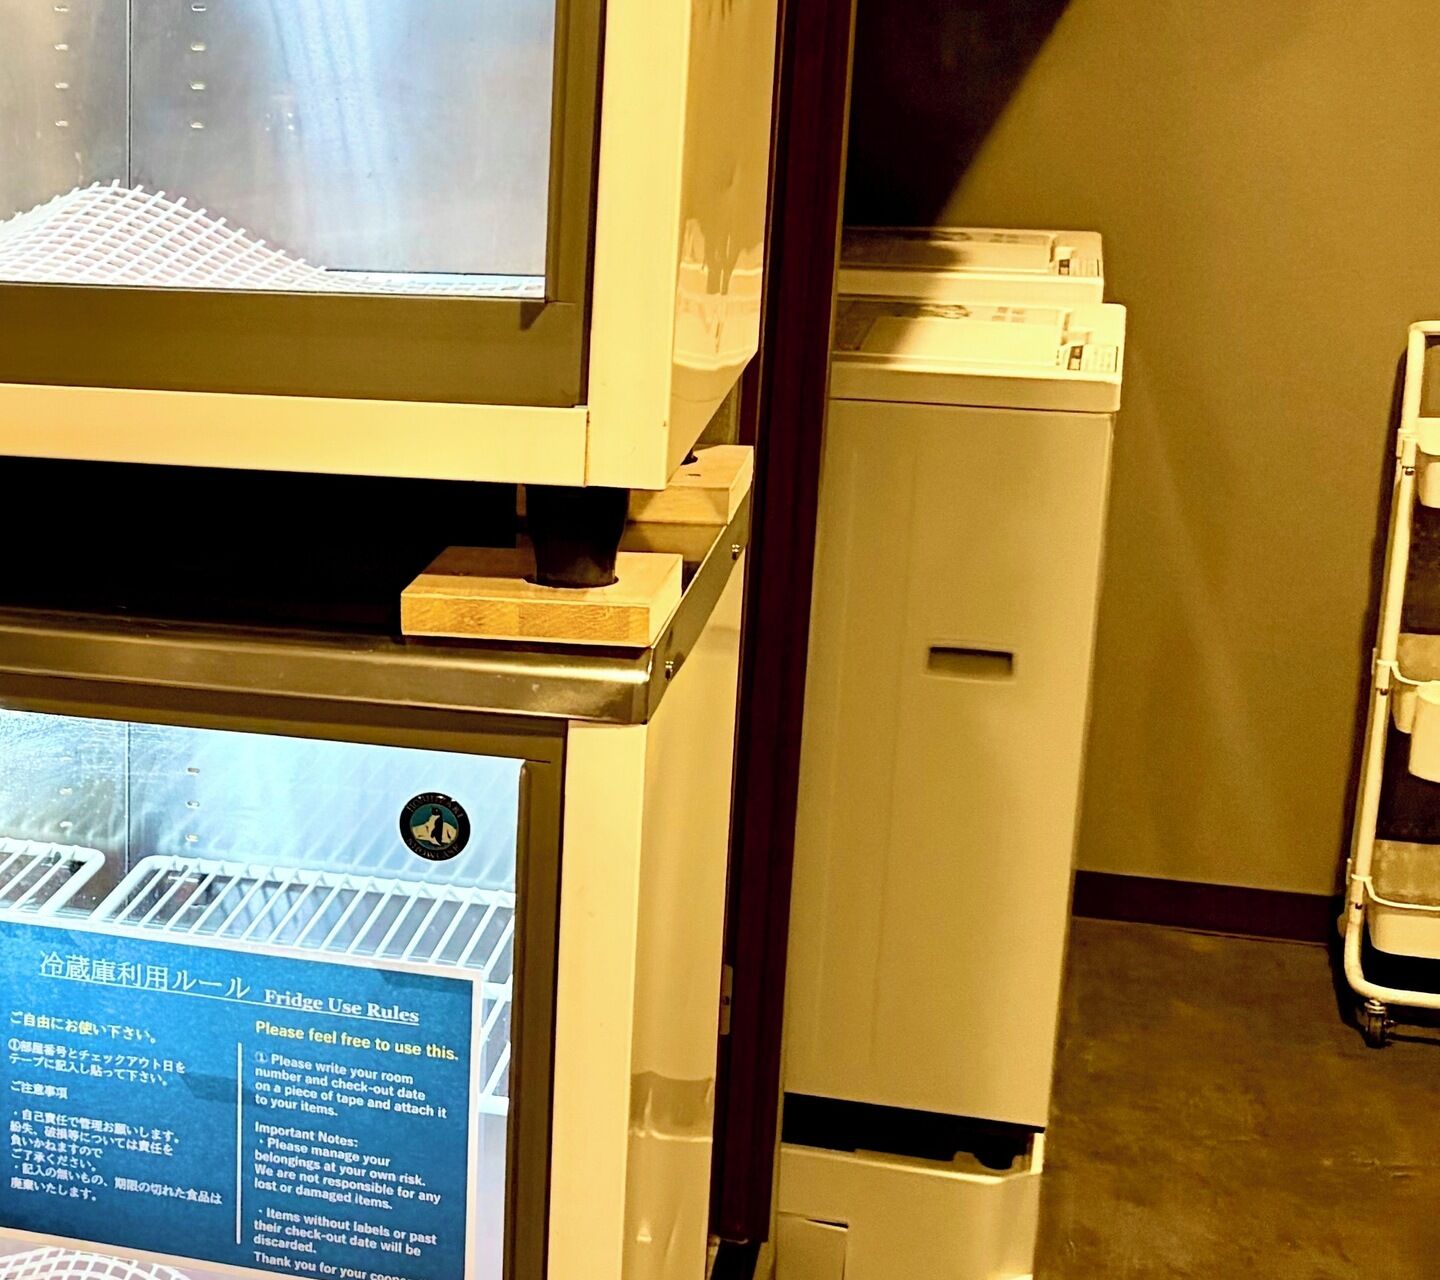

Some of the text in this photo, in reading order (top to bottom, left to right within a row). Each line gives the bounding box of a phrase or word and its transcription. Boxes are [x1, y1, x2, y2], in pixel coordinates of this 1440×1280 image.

[38, 950, 420, 1024] 冷蔵庫利用ルール Fridge Use Rules
[255, 1020, 458, 1060] Please feel free to use this.
[270, 1053, 413, 1085] Please write your room
[254, 1121, 358, 1147] Important Notes:
[254, 1149, 426, 1186] belongings at your own risk.
[266, 1136, 391, 1167] Please manage your
[266, 1207, 437, 1245] Items without labels or past
[253, 1233, 317, 1254] discarded.
[253, 1250, 291, 1268] Thank
[293, 1260, 316, 1271] you
[319, 1261, 337, 1274] for
[339, 1267, 367, 1280] your
